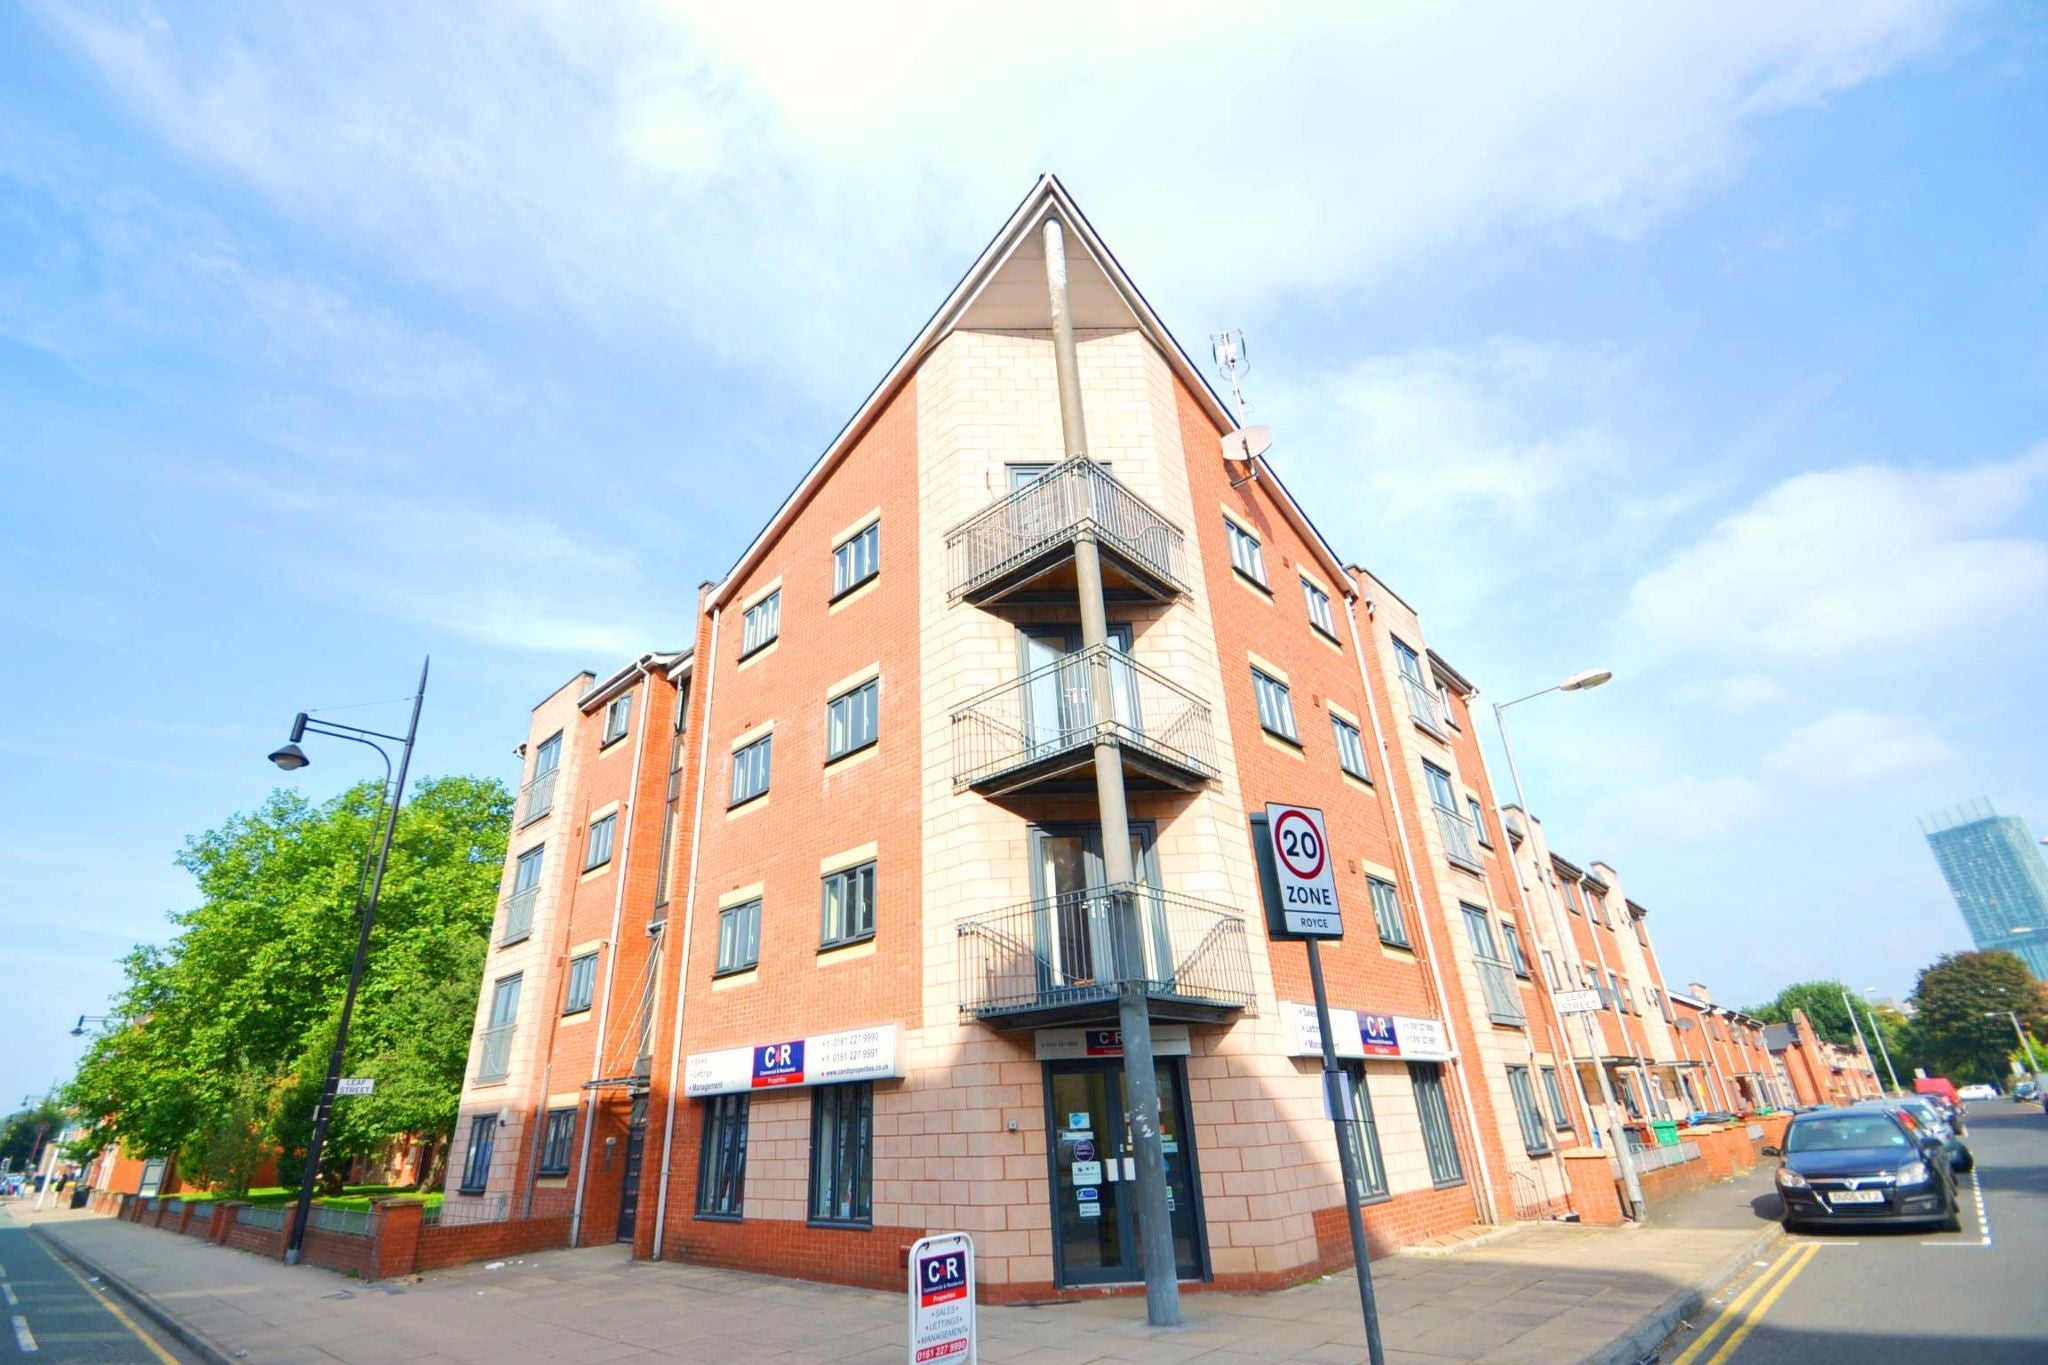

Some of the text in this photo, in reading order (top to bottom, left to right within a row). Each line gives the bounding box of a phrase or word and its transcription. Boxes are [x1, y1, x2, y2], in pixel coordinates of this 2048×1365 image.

[1283, 829, 1317, 859] 20
[1286, 885, 1332, 906] ZONE
[1300, 917, 1329, 929] ROYCE
[340, 1086, 371, 1094] STREET
[692, 1081, 723, 1092] Management
[935, 1305, 956, 1318] SALES
[928, 1316, 960, 1331] LETTINGS
[921, 1326, 966, 1344] MANAGEMENT
[917, 1348, 934, 1361] 0161
